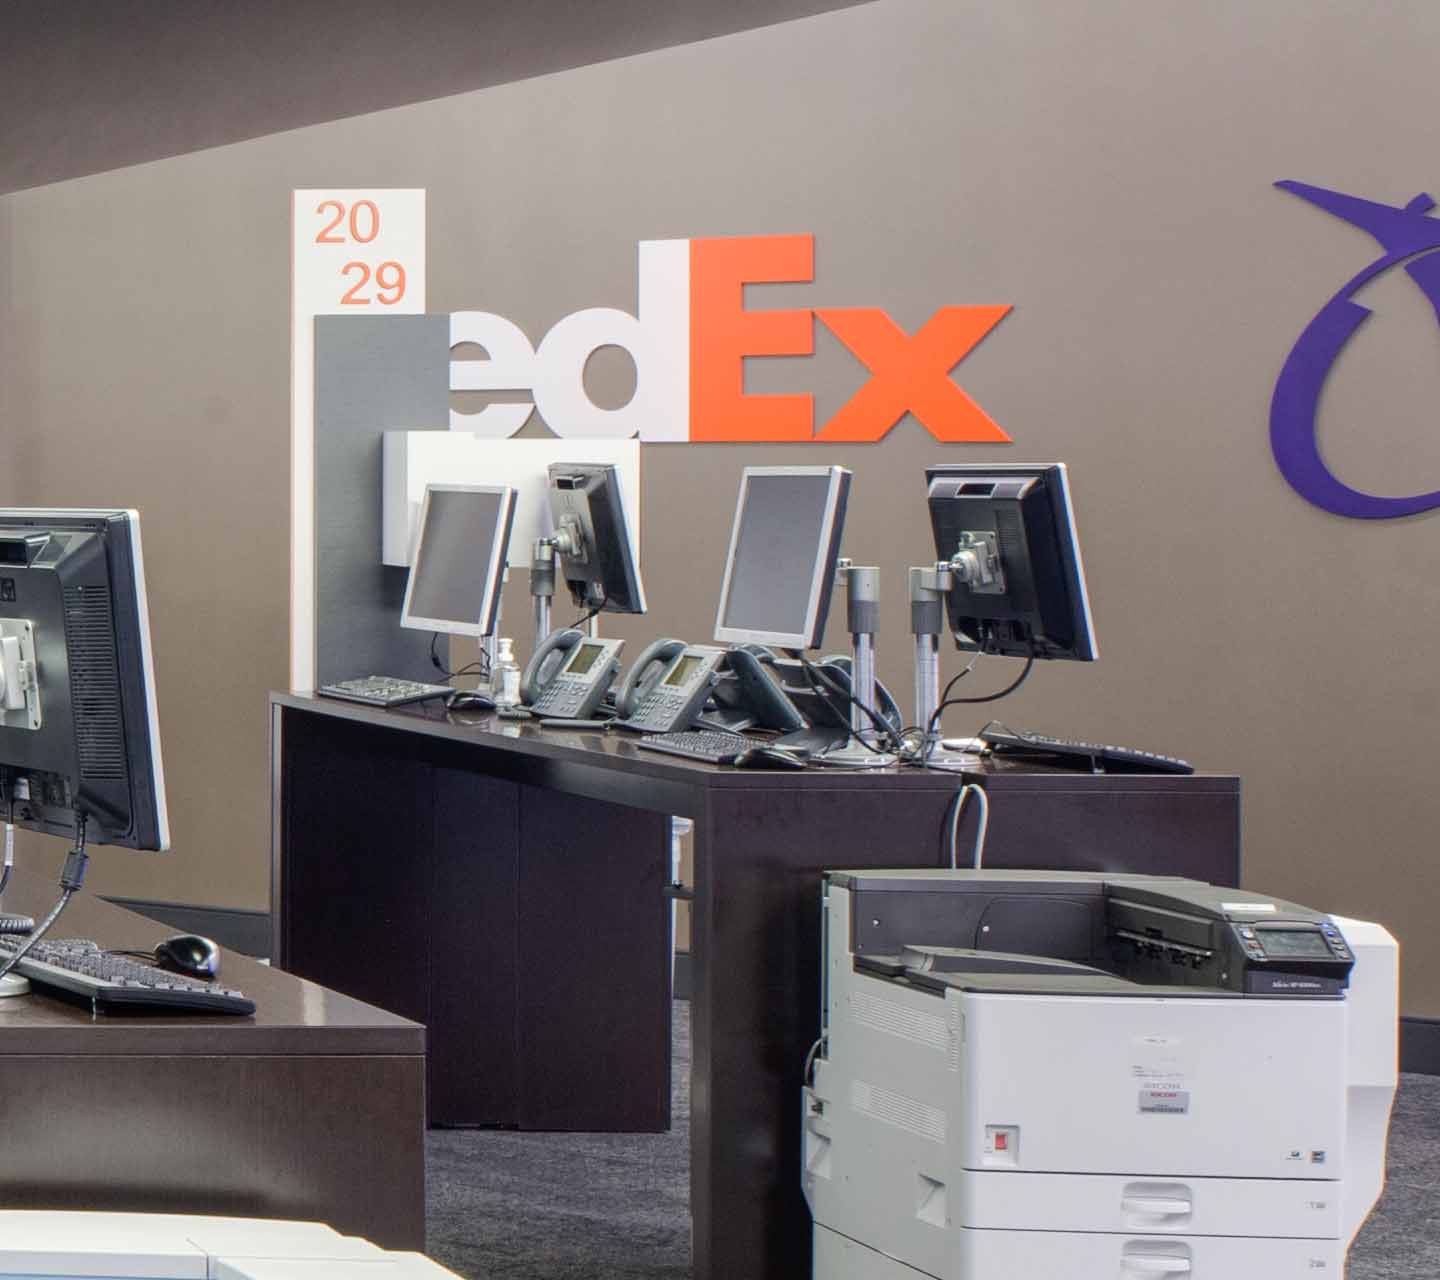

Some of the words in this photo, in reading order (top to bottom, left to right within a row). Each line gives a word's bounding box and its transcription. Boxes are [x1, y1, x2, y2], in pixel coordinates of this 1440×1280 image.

[314, 199, 381, 244] 20
[339, 260, 408, 305] 29
[448, 233, 1014, 443] edEx
